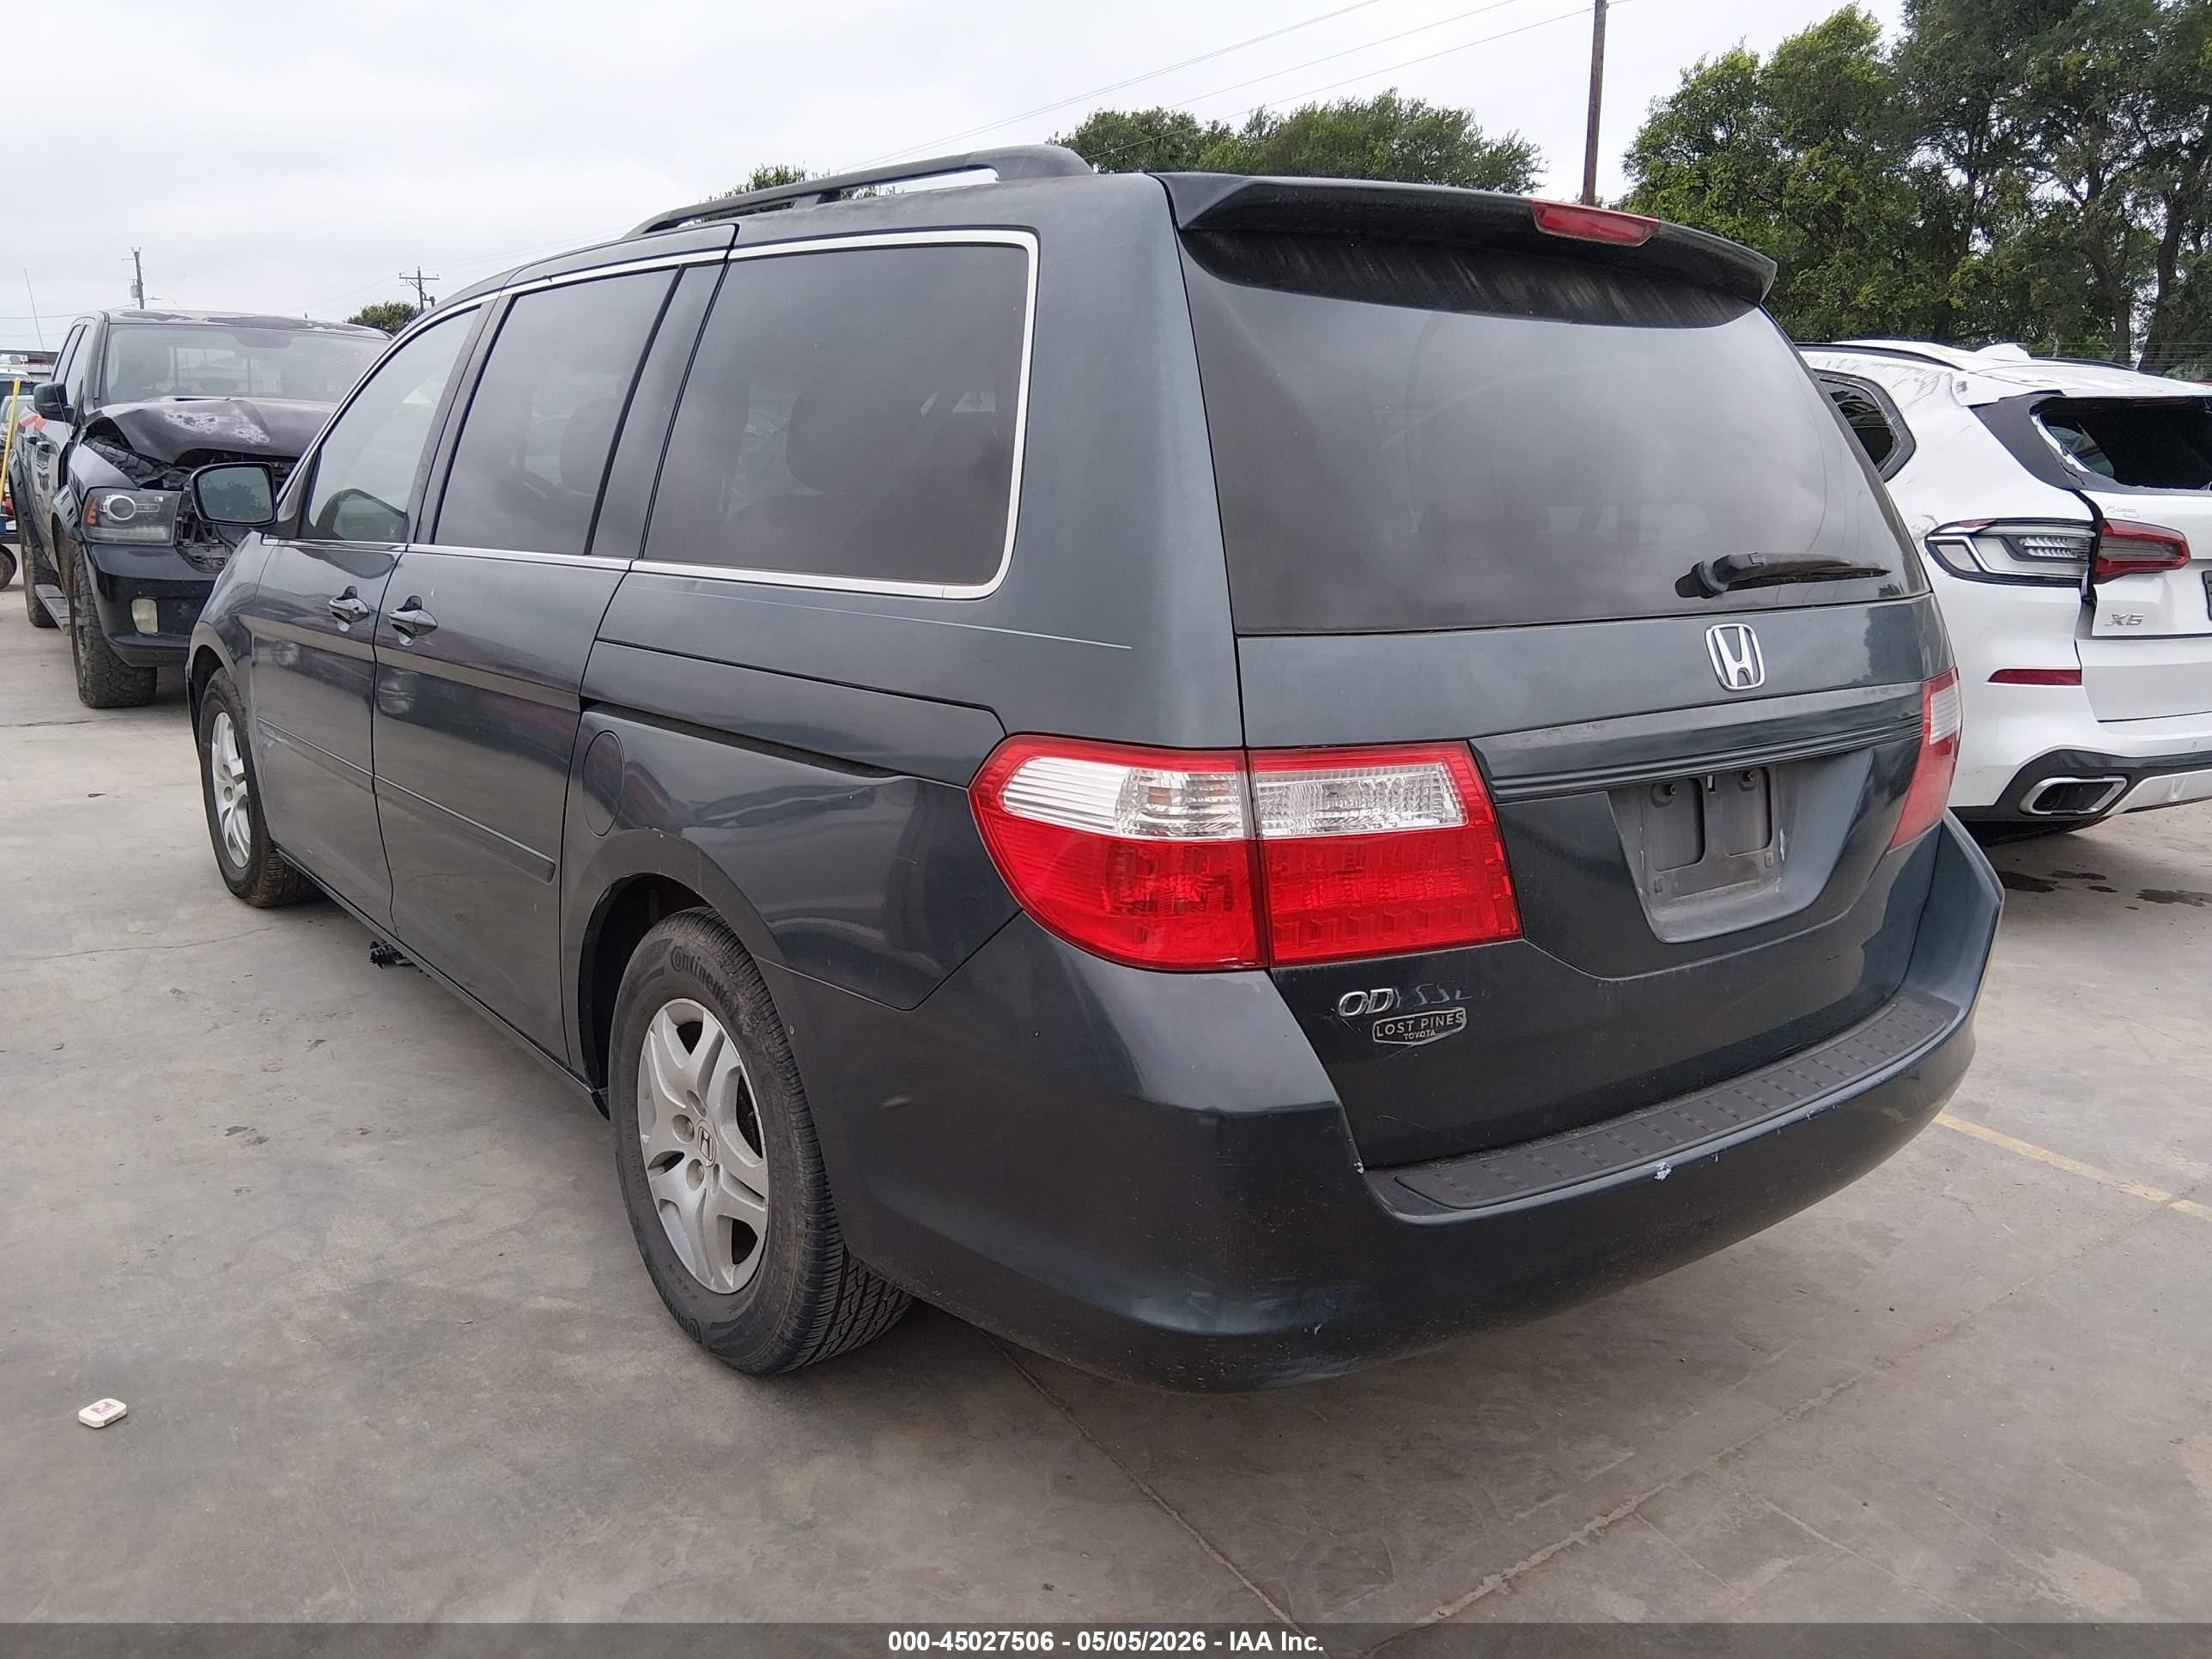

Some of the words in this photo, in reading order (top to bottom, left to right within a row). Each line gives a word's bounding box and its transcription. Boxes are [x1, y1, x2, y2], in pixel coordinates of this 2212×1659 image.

[1376, 1021, 1414, 1037] LOST
[1420, 1013, 1463, 1029] PINES
[1403, 1029, 1437, 1041] TOYOTA
